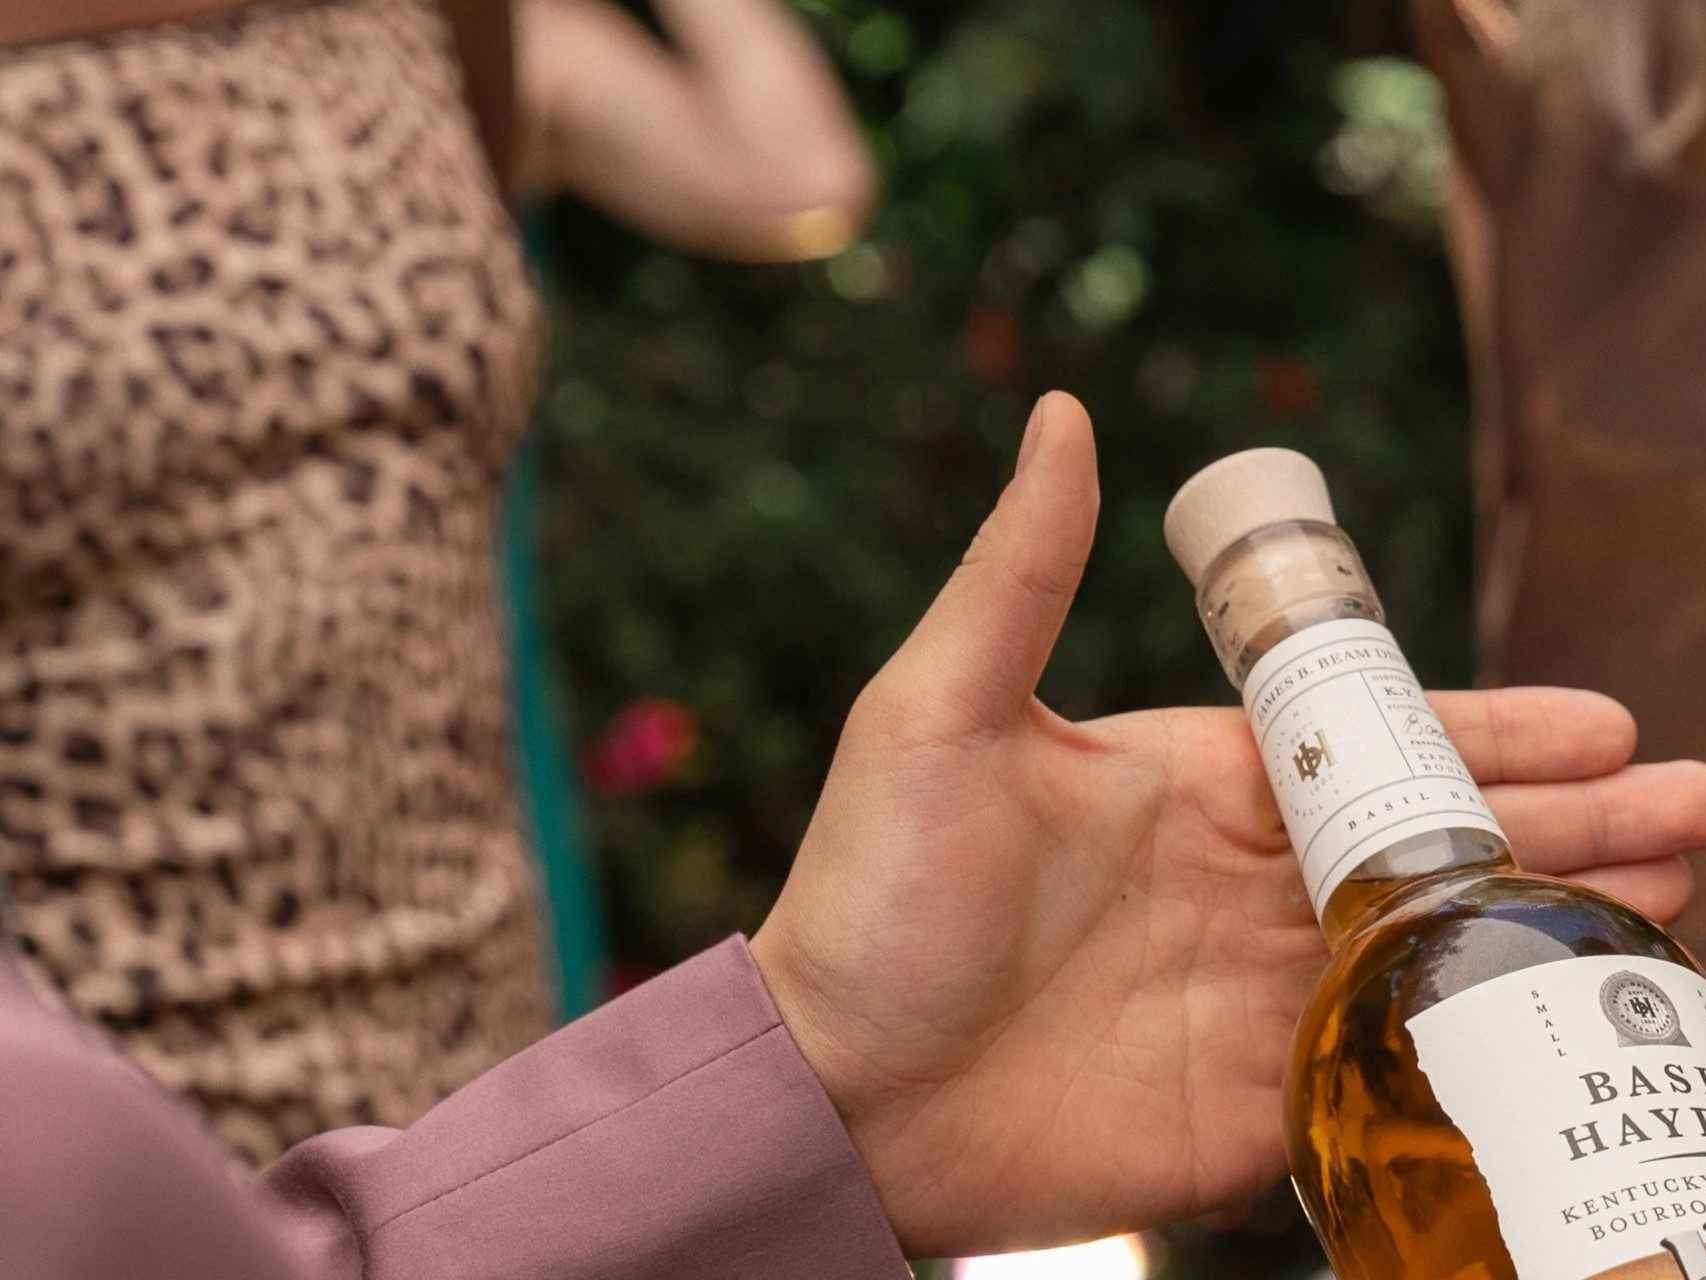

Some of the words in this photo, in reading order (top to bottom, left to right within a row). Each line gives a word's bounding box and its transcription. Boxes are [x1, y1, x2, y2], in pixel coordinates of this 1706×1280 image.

[1256, 675, 1294, 726] JAMES
[1298, 666, 1314, 679] B.
[1318, 648, 1370, 669] BEAM
[1347, 792, 1430, 831] BASIL
[1531, 989, 1567, 1057] SMALL
